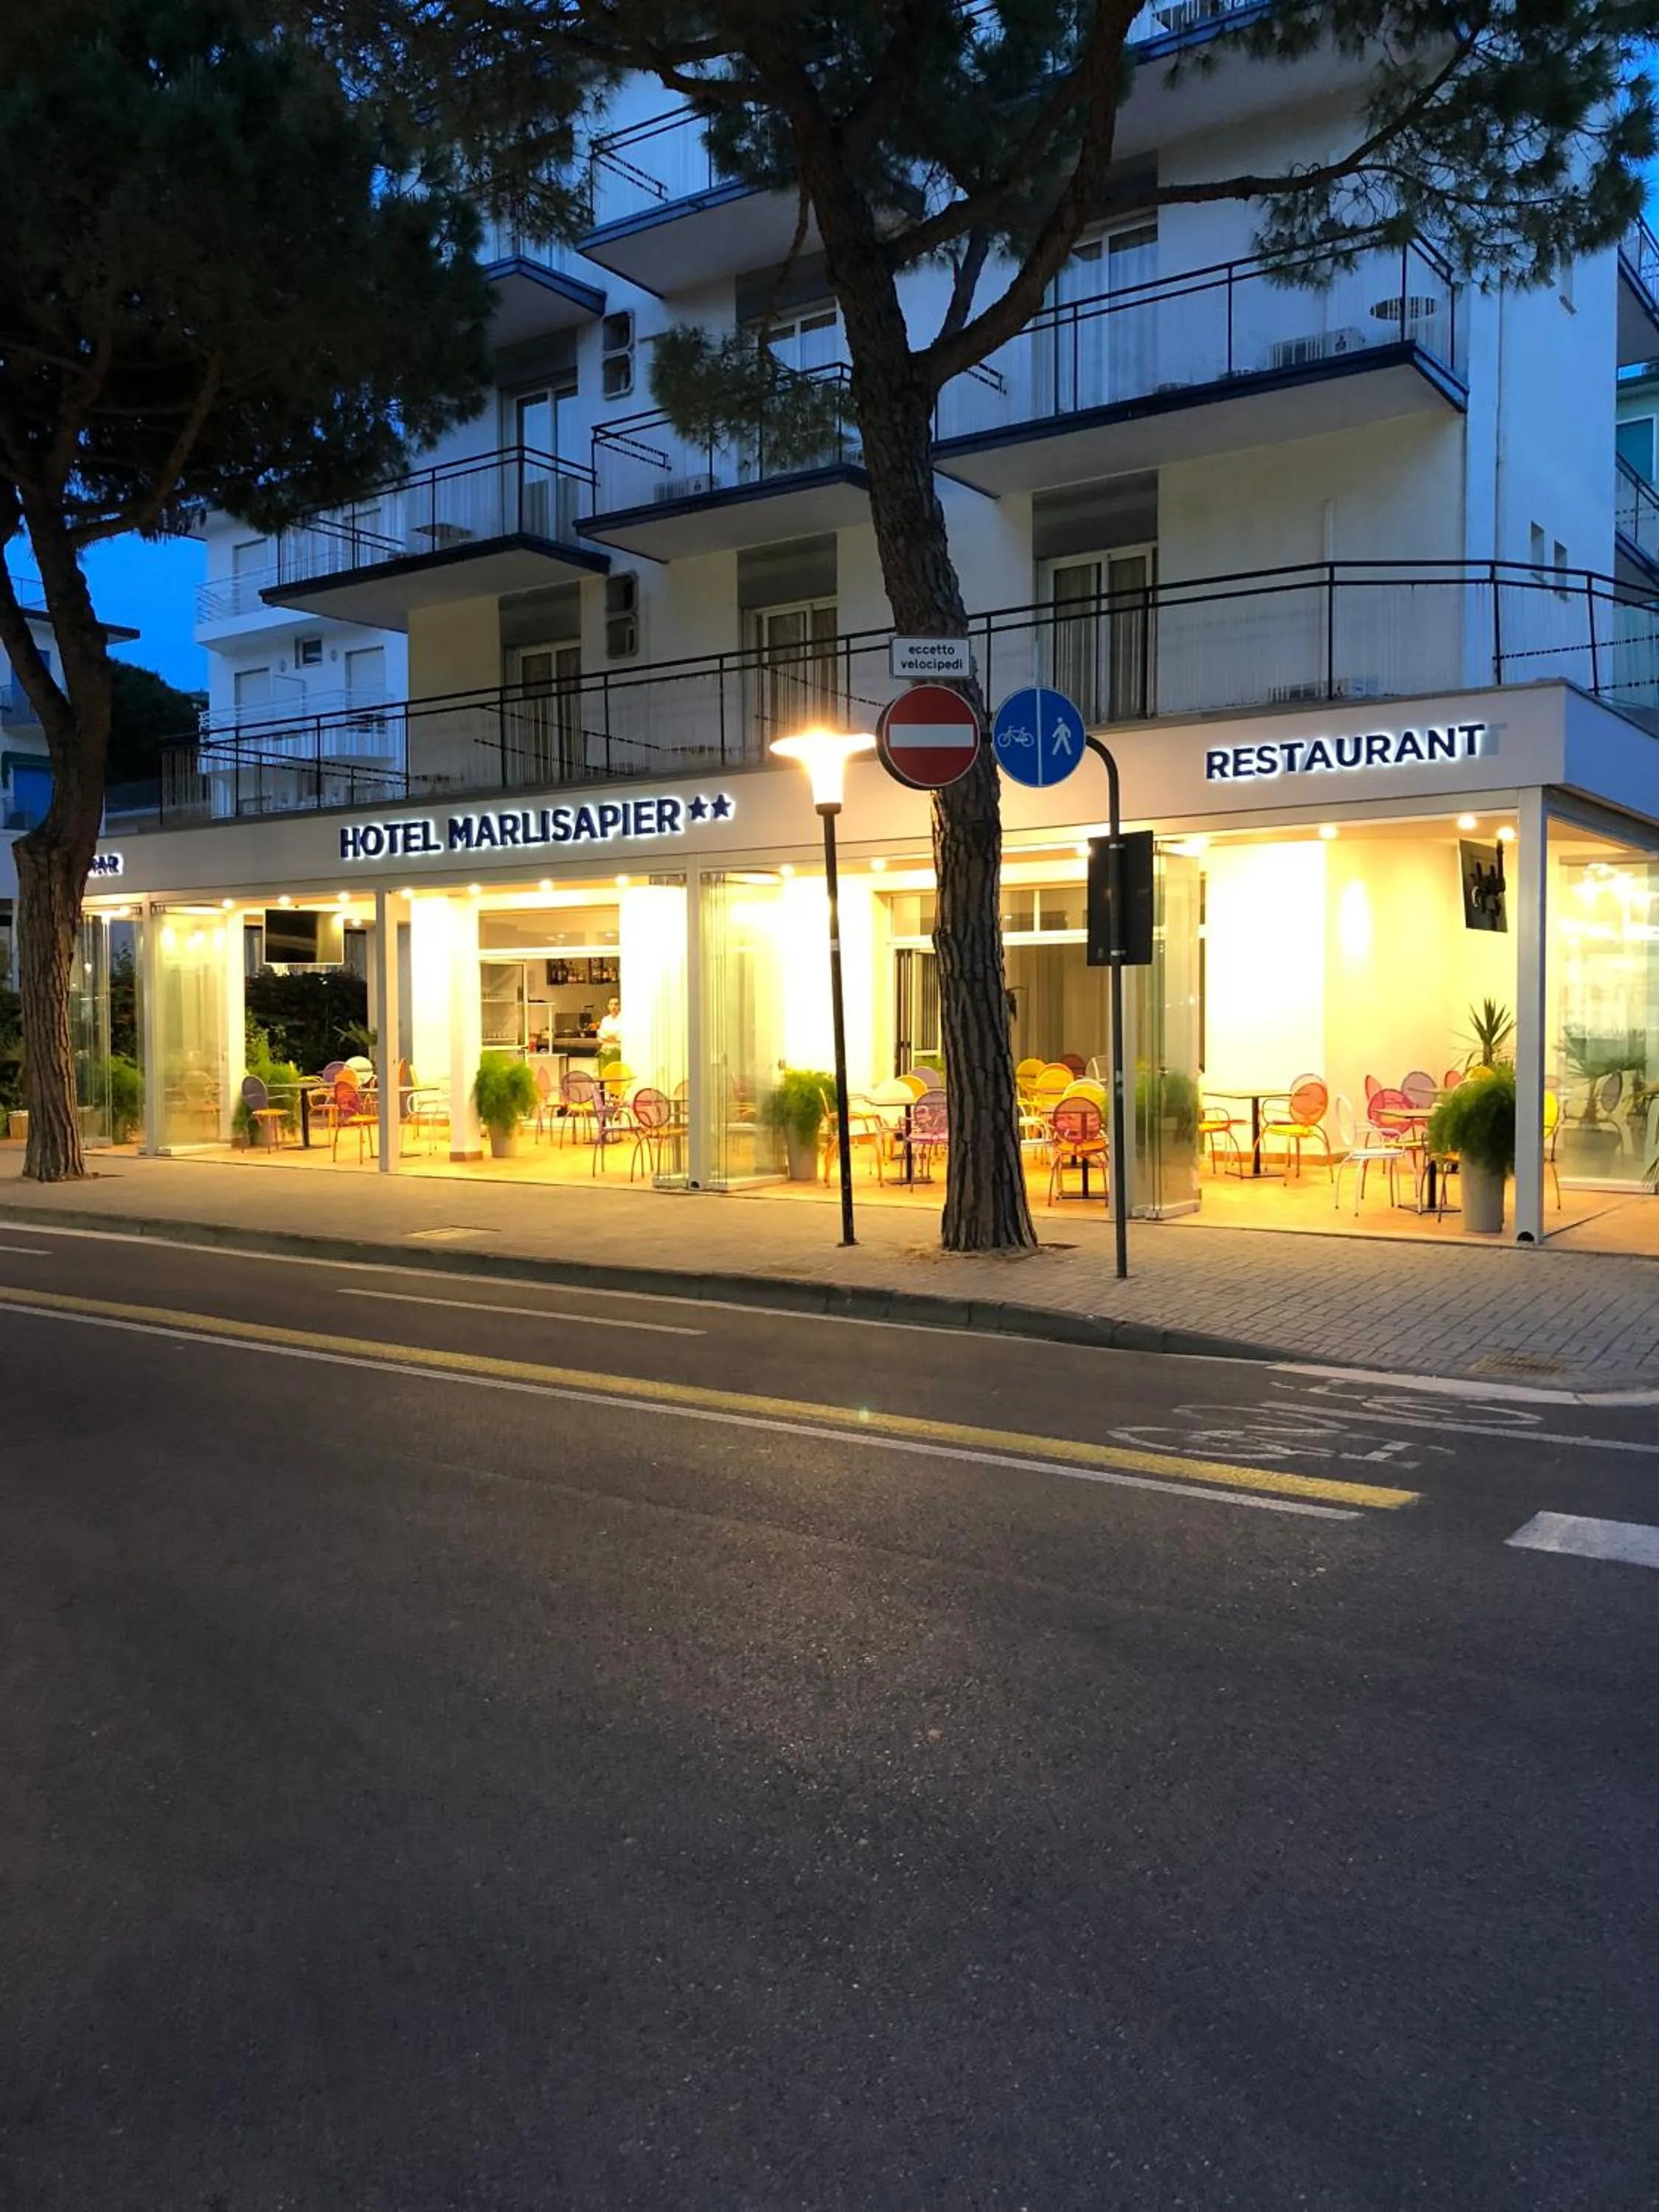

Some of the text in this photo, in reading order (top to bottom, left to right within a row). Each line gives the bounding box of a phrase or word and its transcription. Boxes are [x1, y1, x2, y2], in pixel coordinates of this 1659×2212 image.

[900, 658, 963, 672] velocipedi
[908, 644, 955, 655] eccetto
[1206, 723, 1485, 779] RESTAURANT
[340, 799, 681, 858] HOTEL MARLISAPIER
